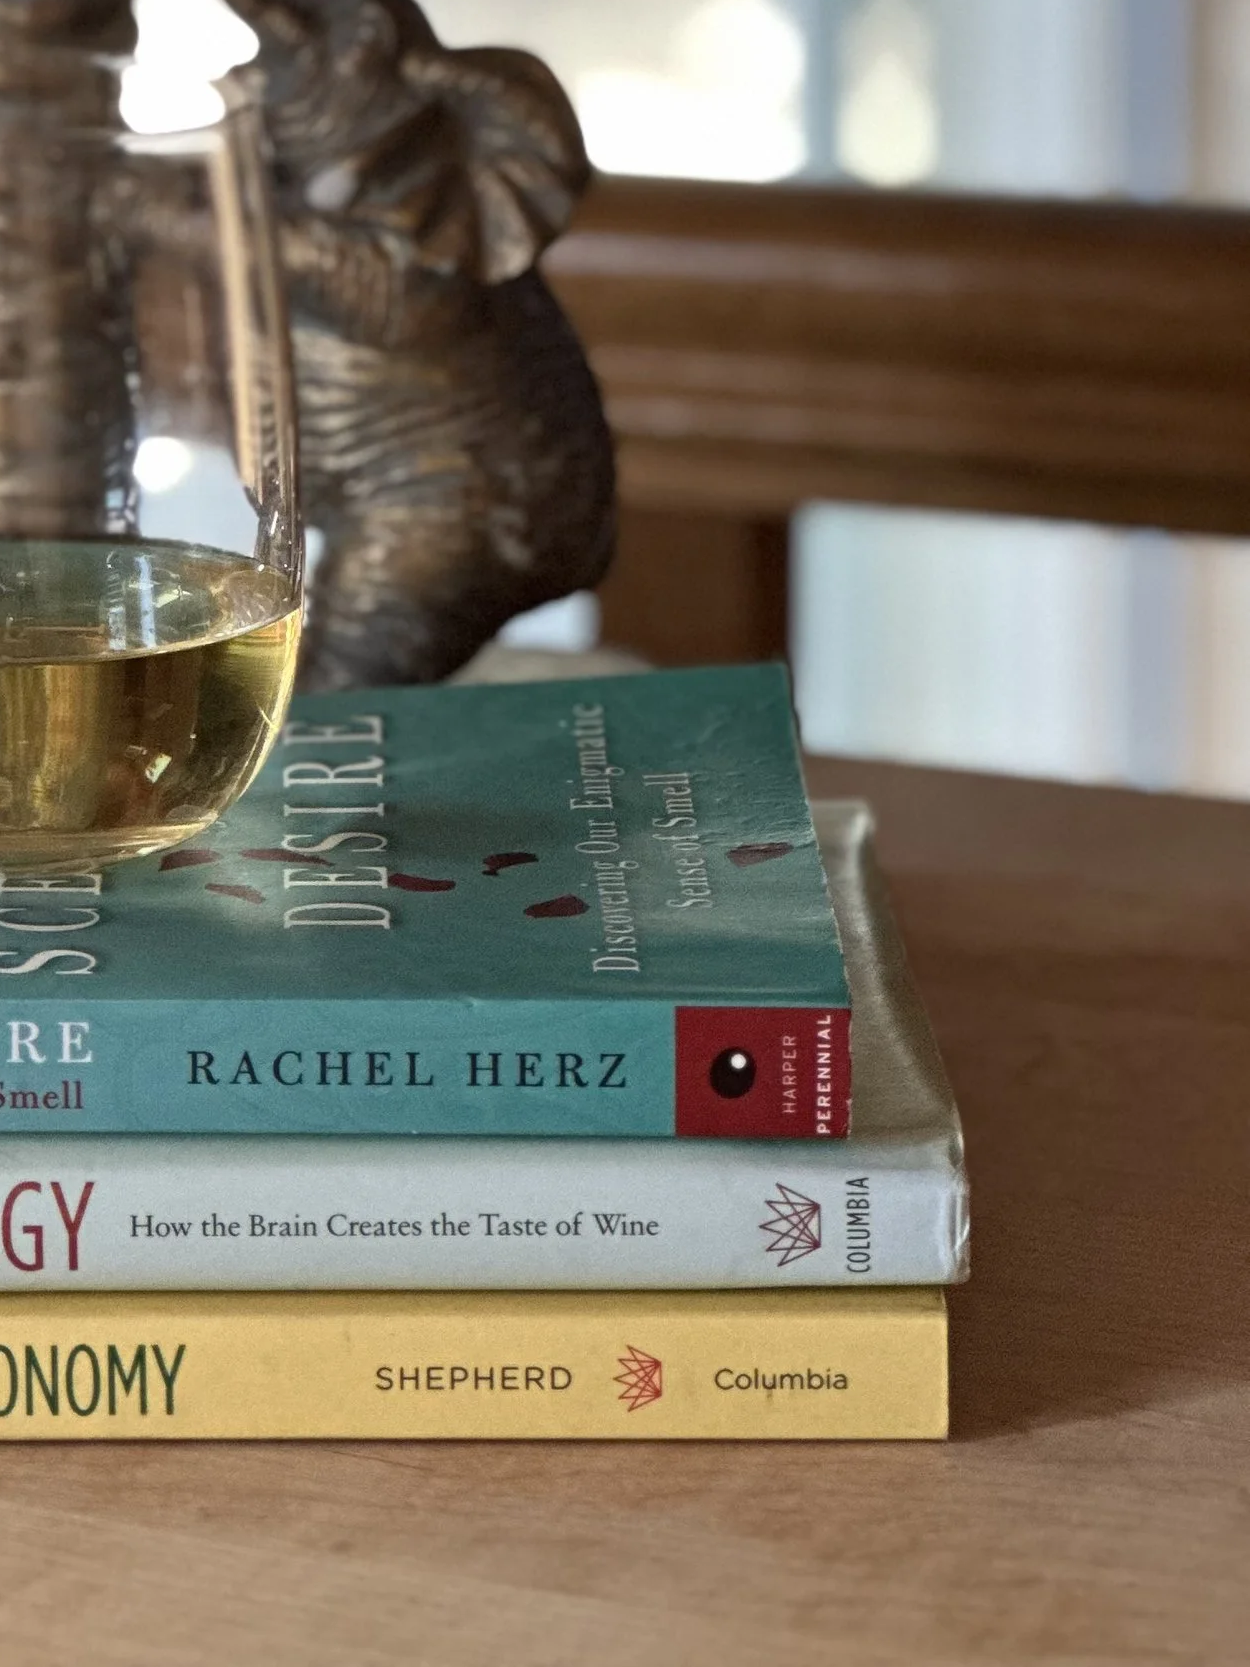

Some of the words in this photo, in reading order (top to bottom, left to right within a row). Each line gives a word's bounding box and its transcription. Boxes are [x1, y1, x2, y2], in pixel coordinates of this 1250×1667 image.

[558, 703, 625, 811] Enigmatic
[280, 714, 392, 930] DESIRE
[642, 772, 698, 828] Smell
[574, 819, 620, 854] Our
[651, 833, 701, 851] of
[665, 857, 713, 909] Sense
[579, 860, 641, 973] Discovering
[186, 1050, 435, 1087] RACHEL
[465, 1051, 628, 1089] HERZ
[781, 1034, 798, 1115] HARPER
[815, 1014, 832, 1135] PERENNIAL
[128, 1212, 194, 1238] How
[200, 1211, 242, 1238] the
[247, 1212, 318, 1238] Brain
[325, 1212, 423, 1238] Creates
[430, 1212, 471, 1237] the
[477, 1212, 548, 1237] Taste
[555, 1211, 584, 1237] of
[592, 1211, 660, 1237] Wine
[845, 1176, 872, 1274] COLUMBIA
[375, 1366, 574, 1392] SHEPHERD
[713, 1367, 849, 1392] Columbia
